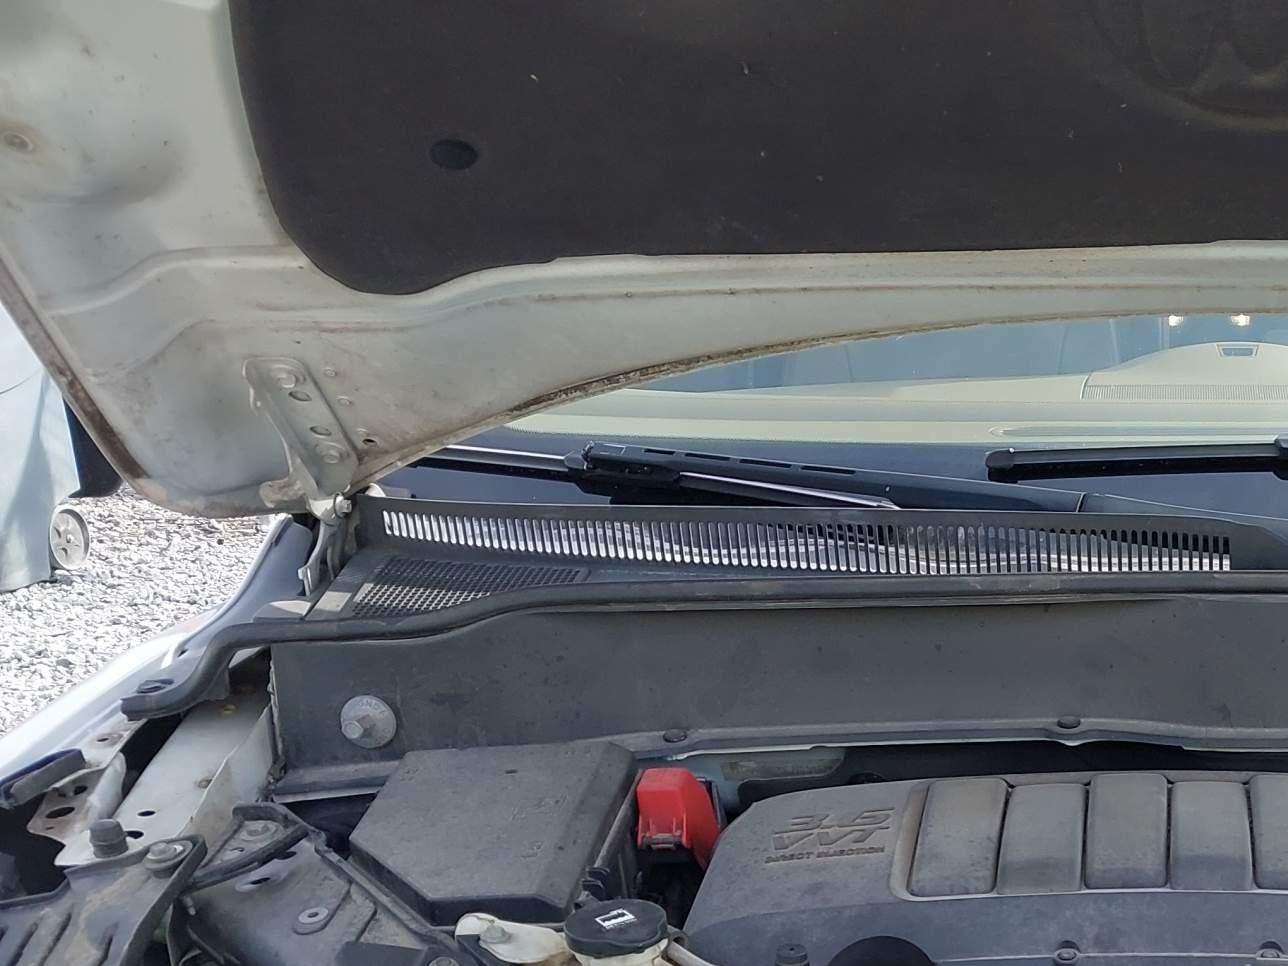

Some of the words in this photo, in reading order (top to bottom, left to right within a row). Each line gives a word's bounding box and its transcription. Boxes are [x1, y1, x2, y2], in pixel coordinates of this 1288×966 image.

[772, 826, 890, 850] VVT
[765, 852, 812, 864] DIRECT
[816, 846, 885, 859] INJECTION
